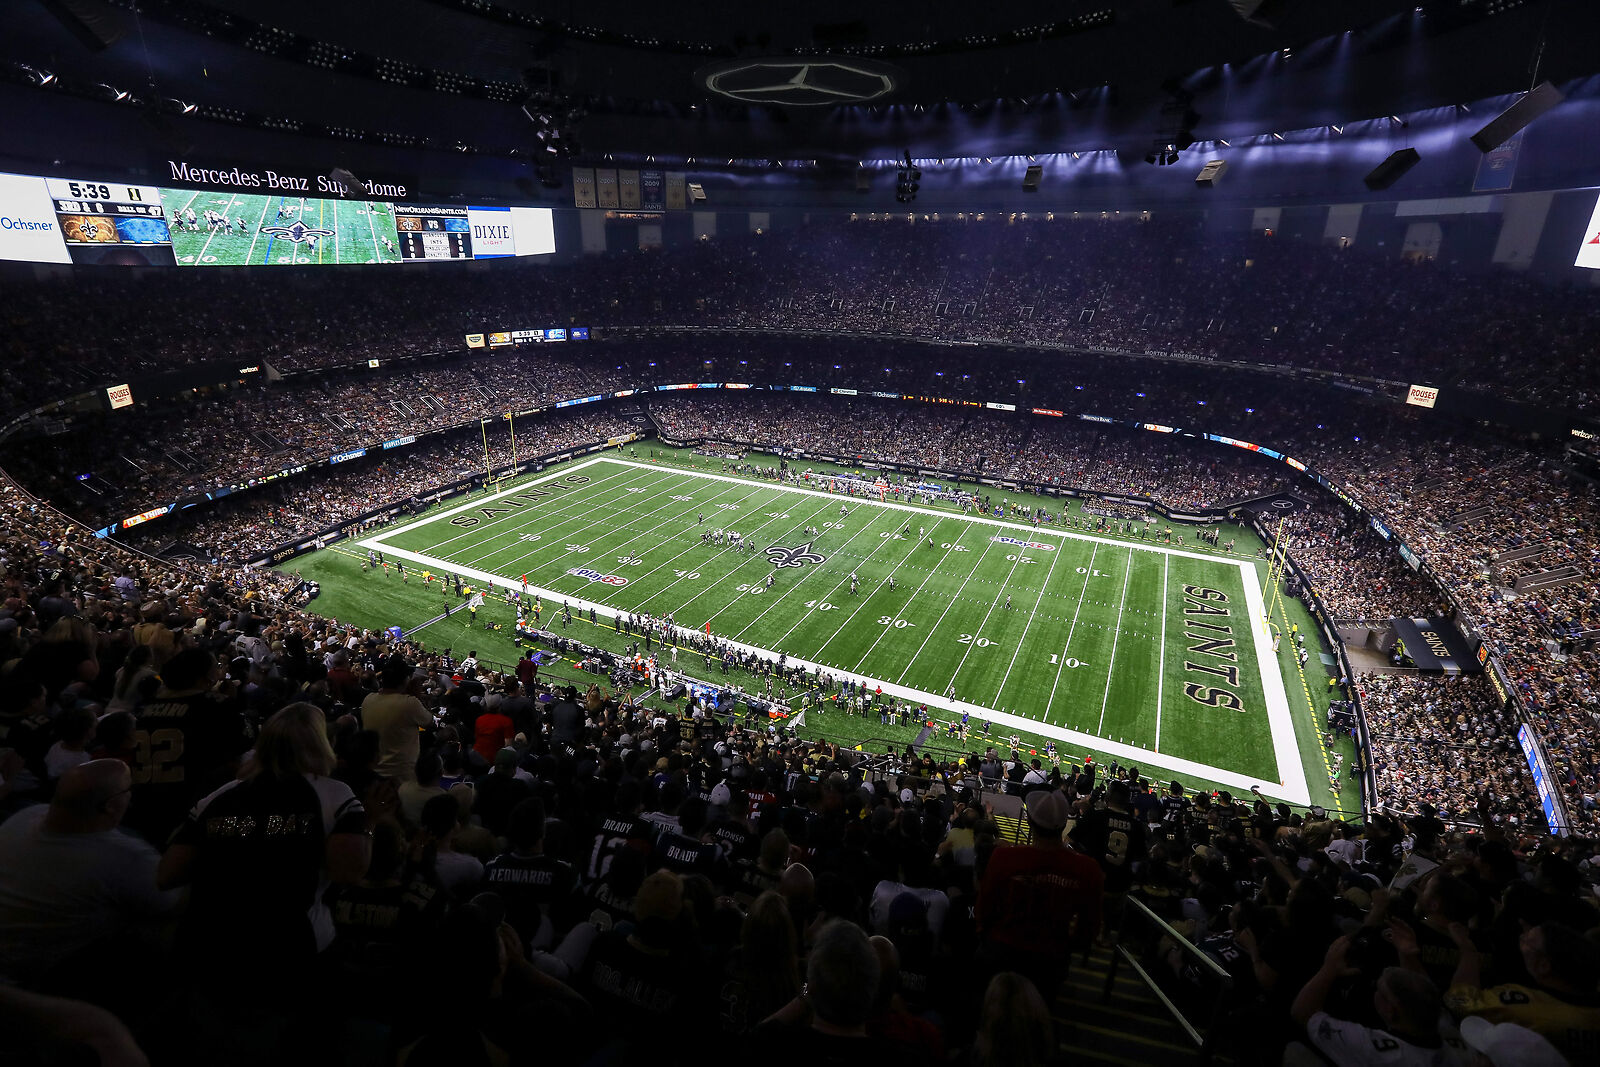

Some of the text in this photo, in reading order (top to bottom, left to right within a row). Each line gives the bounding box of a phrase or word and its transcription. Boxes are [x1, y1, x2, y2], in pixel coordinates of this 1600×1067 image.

[168, 160, 407, 198] Mercedes-Benz Supdome
[69, 182, 111, 200] 5:39
[1, 216, 53, 232] Ochsner
[427, 220, 439, 229] VS
[474, 225, 510, 239] DIXIE
[109, 388, 130, 401] ROUSES
[1410, 388, 1436, 400] ROUSES
[1571, 429, 1593, 440] verizon
[337, 450, 363, 463] Ochsner
[451, 474, 591, 528] SAINTS
[735, 583, 766, 596] 50
[805, 599, 833, 611] 40
[876, 615, 908, 629] 30
[956, 632, 991, 648] 20
[1182, 583, 1246, 713] SAINTS
[1420, 630, 1452, 658] SAINTS
[1048, 653, 1080, 669] 10
[602, 818, 633, 835] BRADY
[715, 827, 746, 845] ALONSO
[666, 844, 699, 864] BRADY
[1105, 830, 1129, 866] 9
